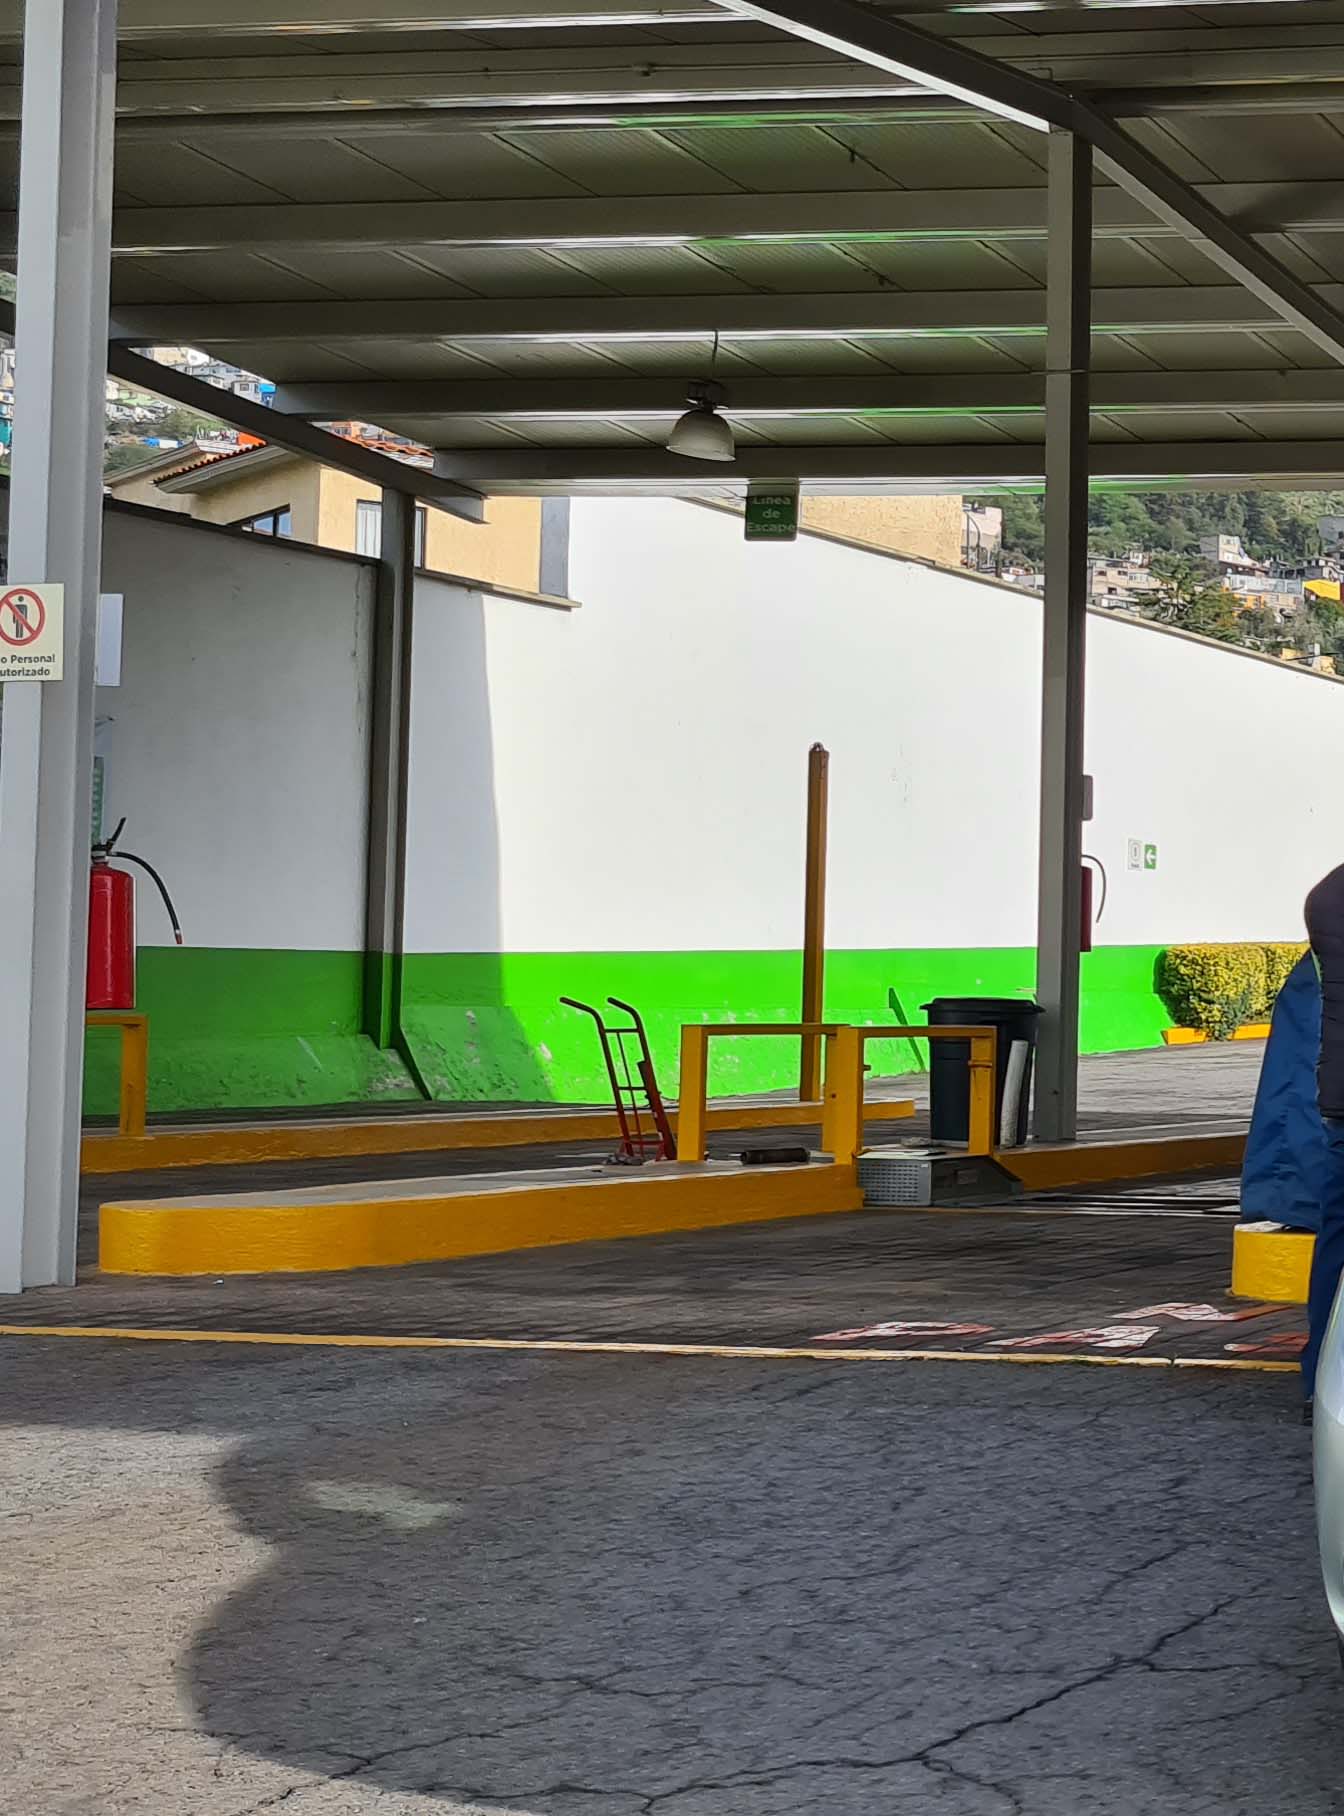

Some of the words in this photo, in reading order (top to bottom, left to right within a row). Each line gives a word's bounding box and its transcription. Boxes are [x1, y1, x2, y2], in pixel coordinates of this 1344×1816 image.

[762, 508, 781, 519] de
[10, 654, 55, 664] Personal
[0, 667, 50, 677] utorizado
